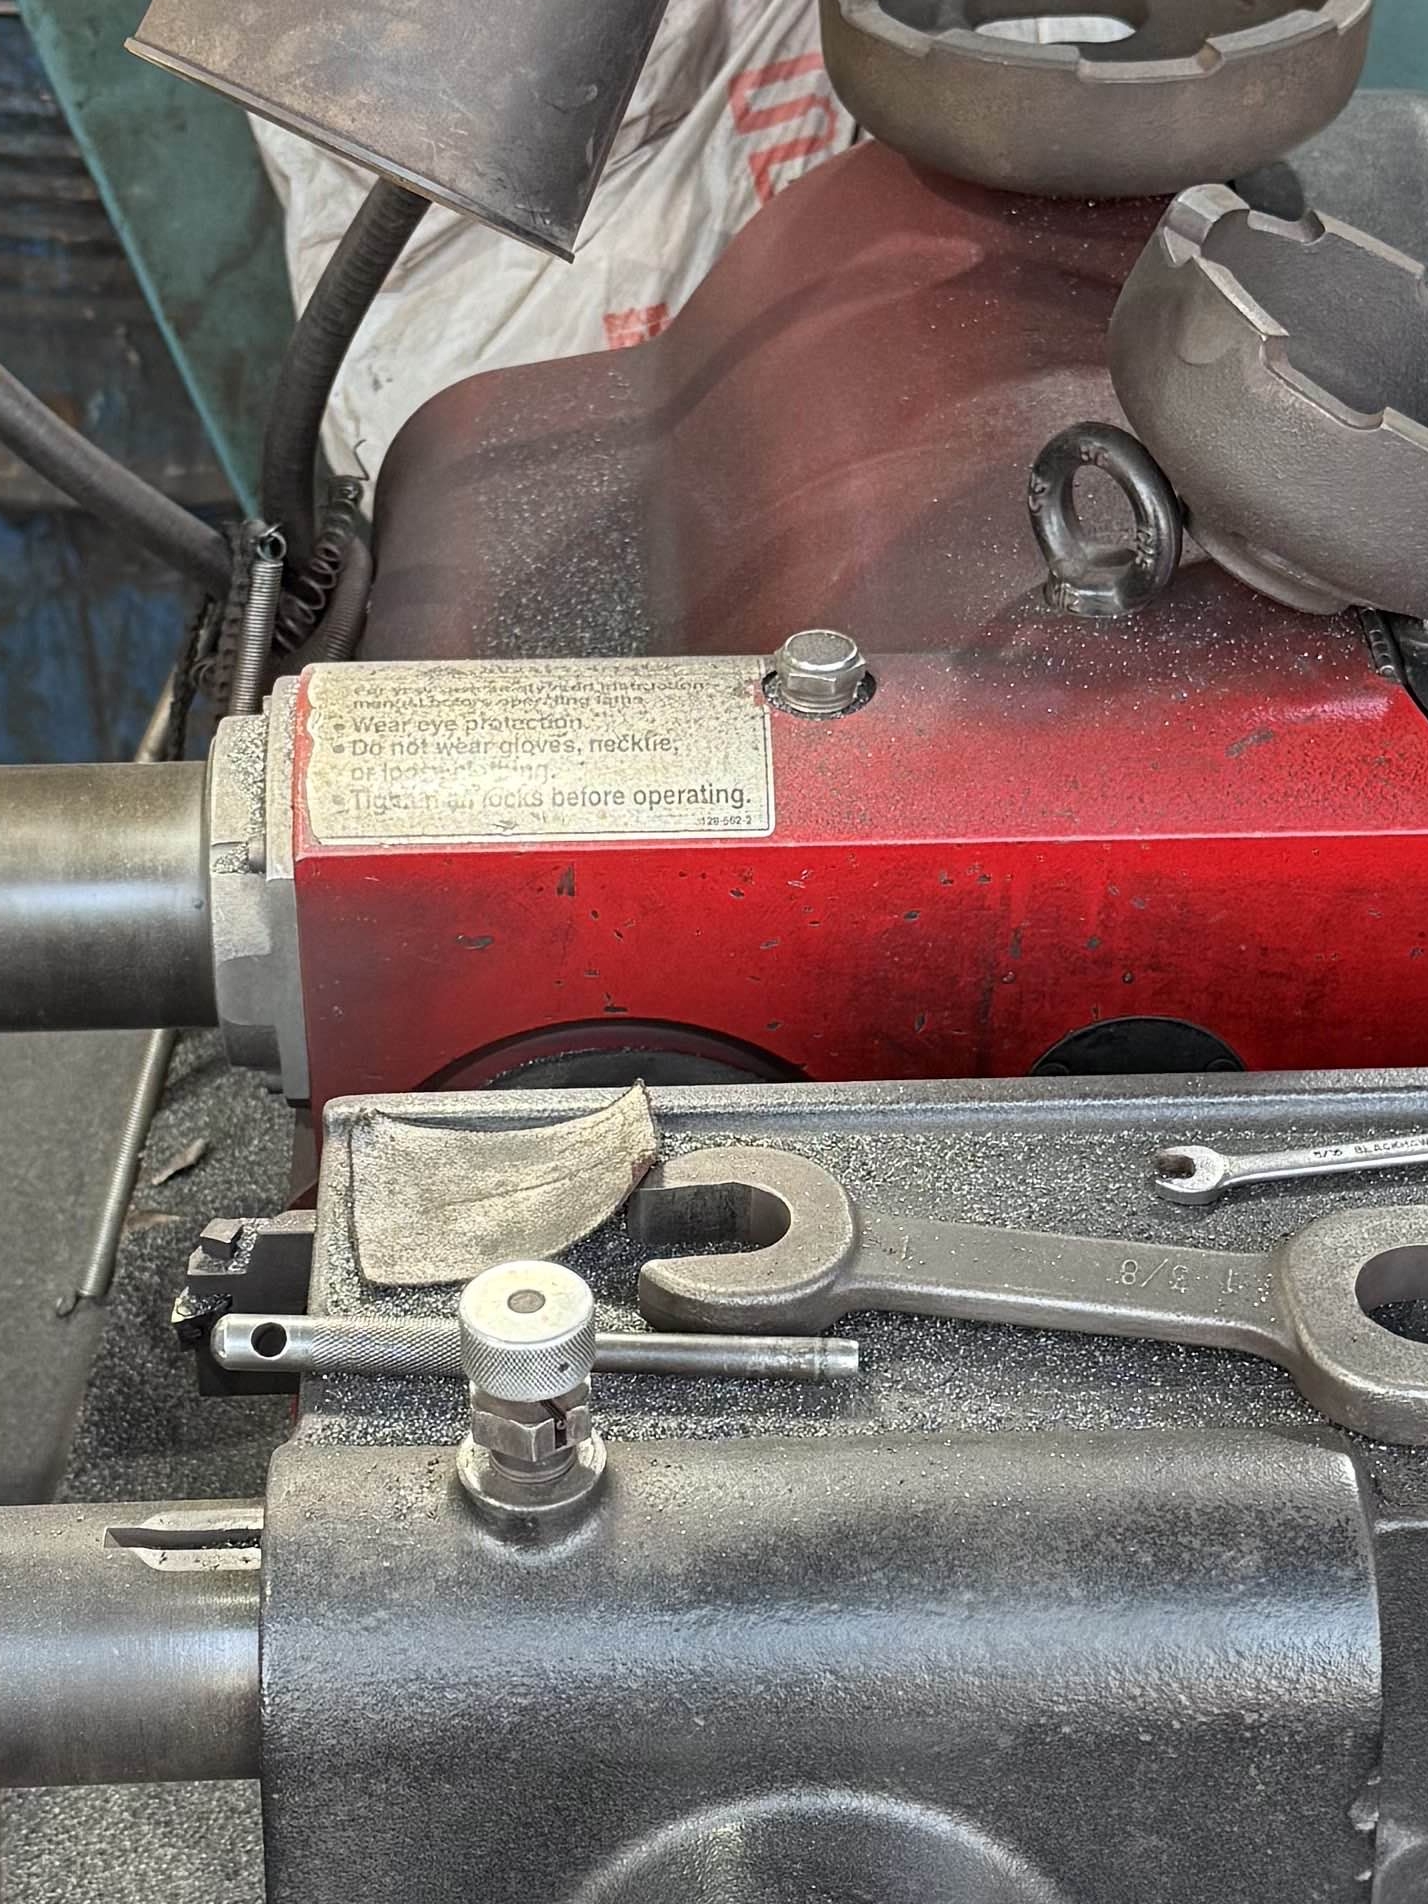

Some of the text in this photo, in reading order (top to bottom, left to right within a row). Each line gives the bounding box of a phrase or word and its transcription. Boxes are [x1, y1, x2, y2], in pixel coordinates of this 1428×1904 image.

[351, 716, 409, 734] Wear
[417, 718, 458, 737] eye
[351, 739, 382, 756] Do
[391, 737, 424, 756] not
[436, 737, 495, 756] wear
[551, 784, 625, 808] before
[633, 782, 752, 811] operating.
